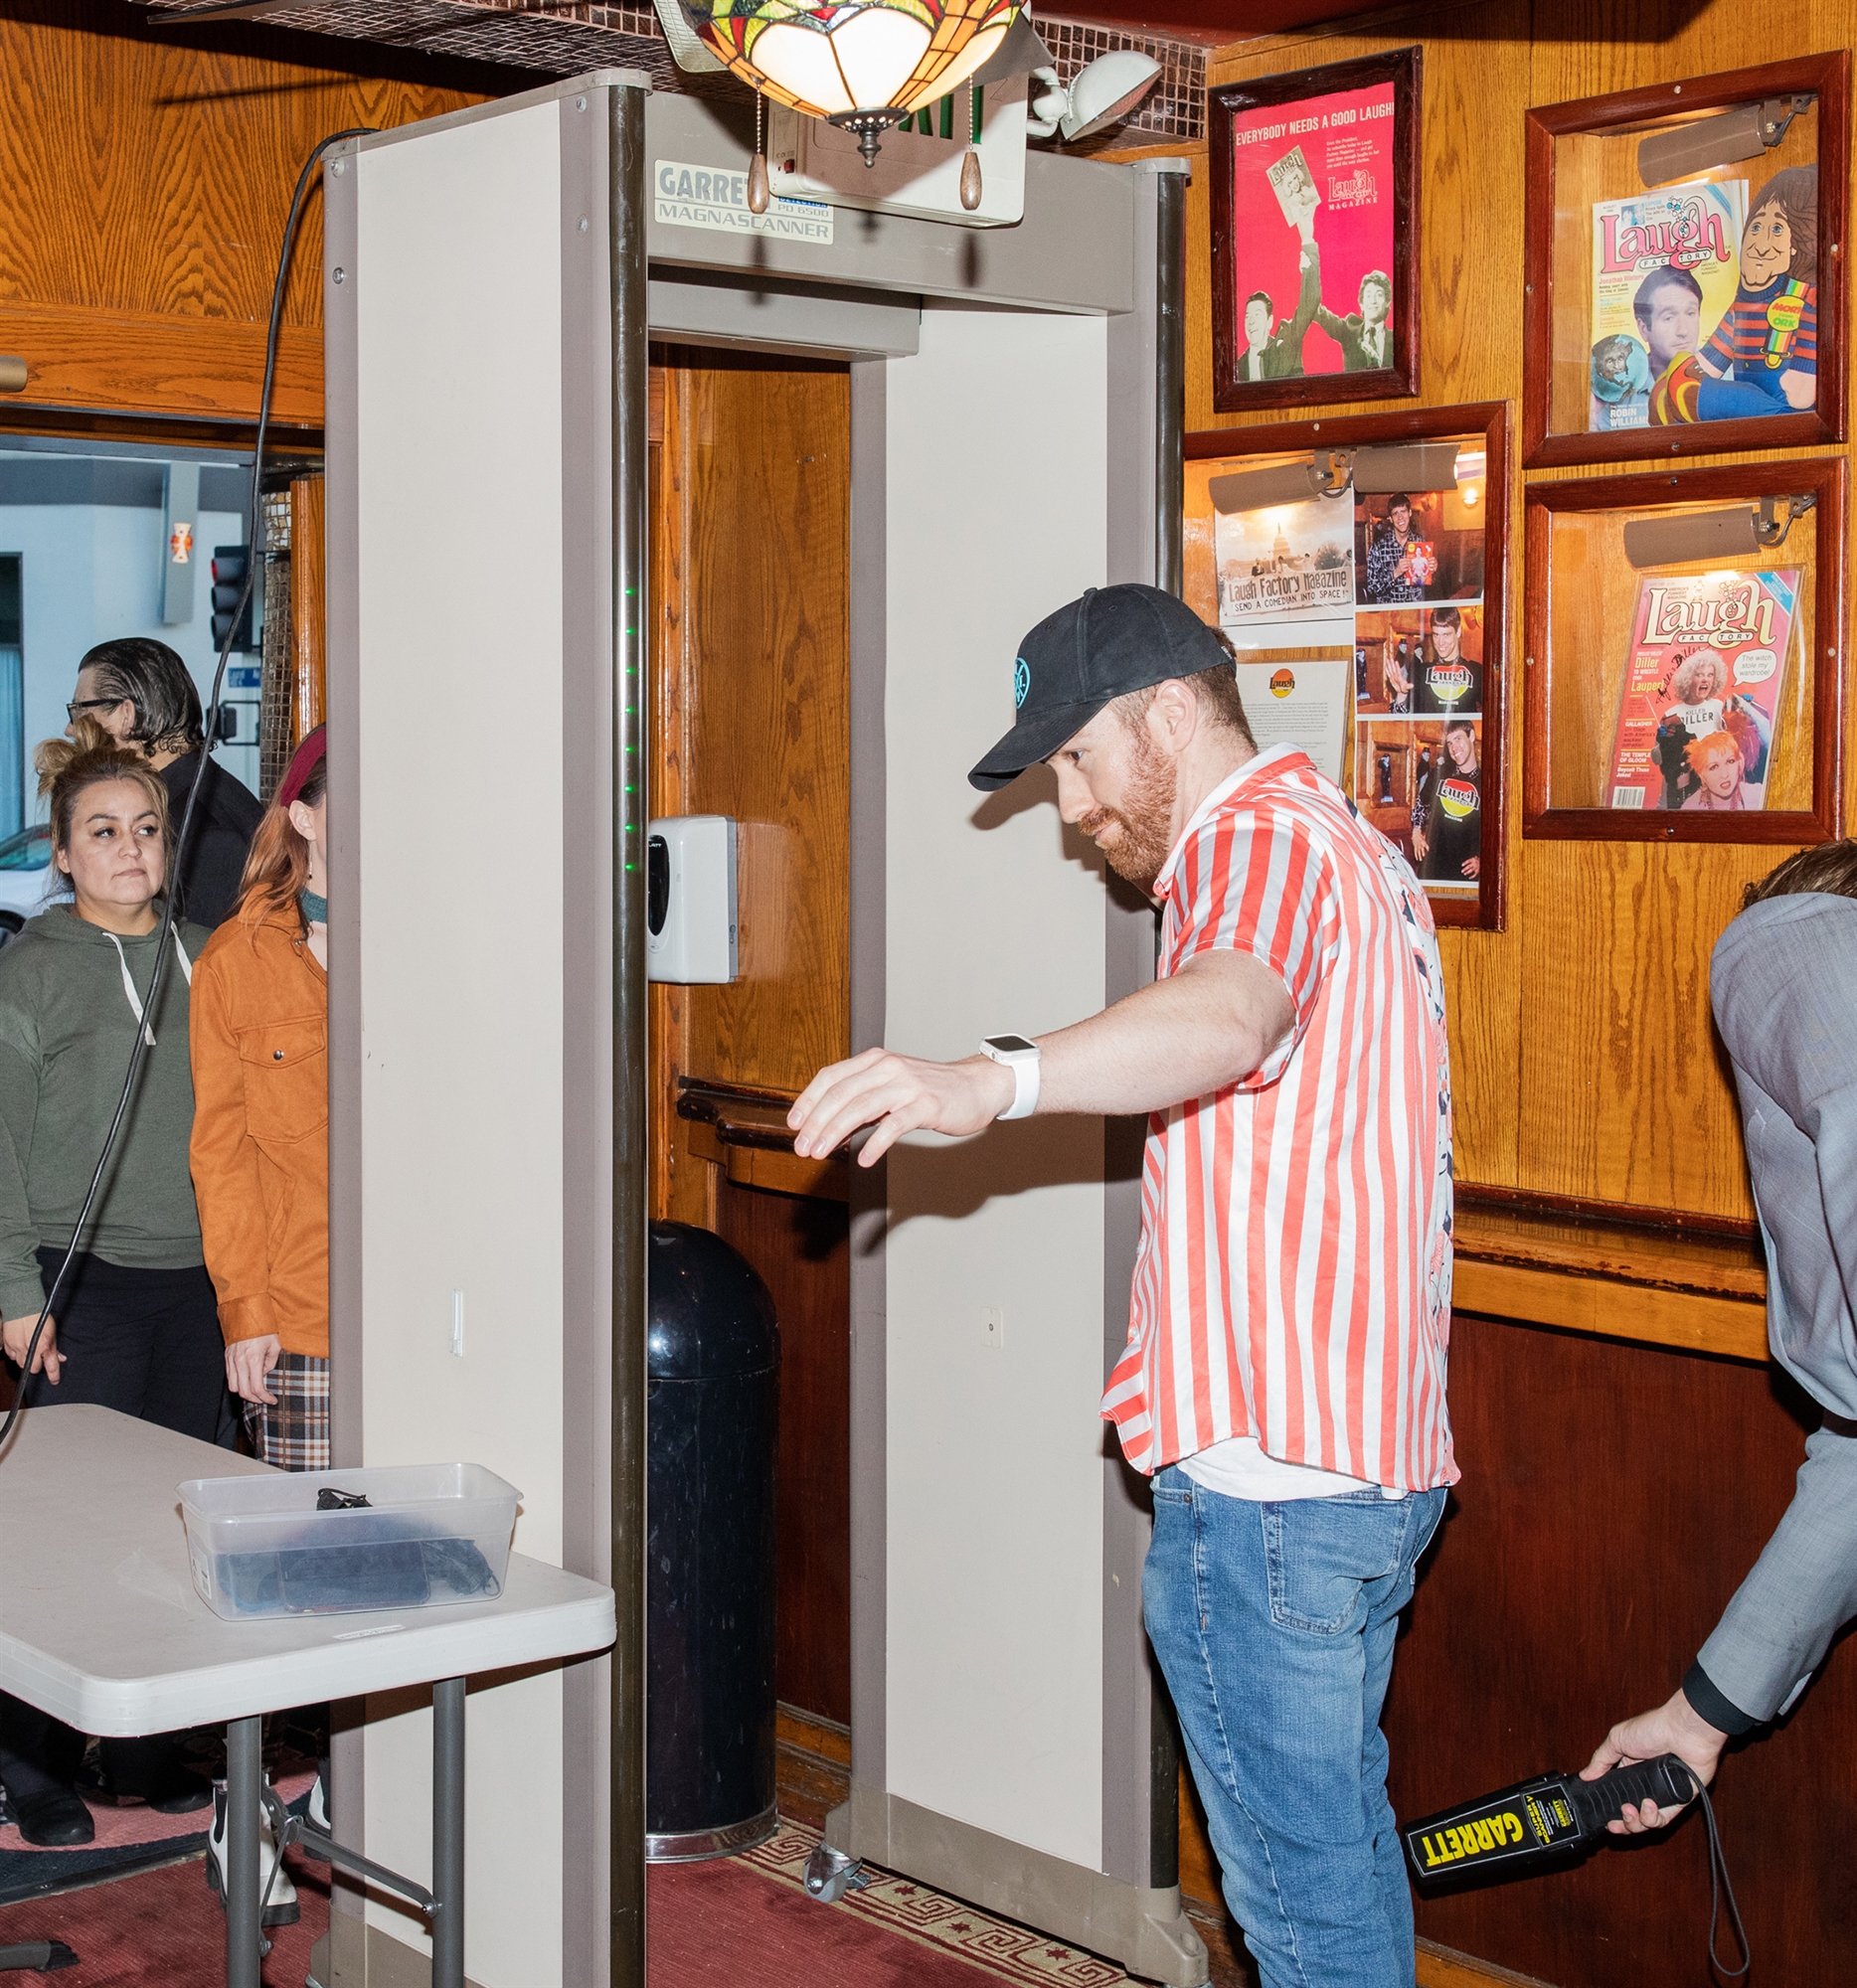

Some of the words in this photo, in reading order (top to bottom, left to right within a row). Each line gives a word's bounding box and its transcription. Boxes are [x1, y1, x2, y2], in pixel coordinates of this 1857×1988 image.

[1236, 123, 1287, 146] EVERYBODY
[1290, 117, 1319, 135] NEEDS
[1322, 115, 1329, 128] A
[1331, 109, 1356, 127] GOOD
[1359, 101, 1394, 121] LAUGH!
[659, 167, 770, 209] GARRE
[1328, 169, 1378, 202] Laugh
[778, 204, 793, 212] PD
[798, 206, 829, 218] 6500
[1329, 197, 1378, 211] MAGAZINE
[659, 203, 829, 238] MAGNASCANNER
[1601, 196, 1731, 273] Laugh
[1644, 251, 1708, 266] FACTORY
[1610, 408, 1637, 418] ROBIN
[1229, 580, 1257, 602] Laugh
[1260, 574, 1300, 598] Factory
[1303, 570, 1347, 591] Magazine
[1264, 597, 1297, 608] COMEDIAN
[1301, 592, 1315, 602] INTO
[1641, 580, 1776, 649] Laugh
[1681, 633, 1751, 641] FACTORY
[1635, 657, 1660, 668] Diller
[1269, 677, 1296, 689] Laugh
[1426, 666, 1474, 688] Laugh
[1631, 680, 1665, 693] Lauper!
[1436, 779, 1481, 810] Laugh
[1422, 1812, 1523, 1868] GARRETT
